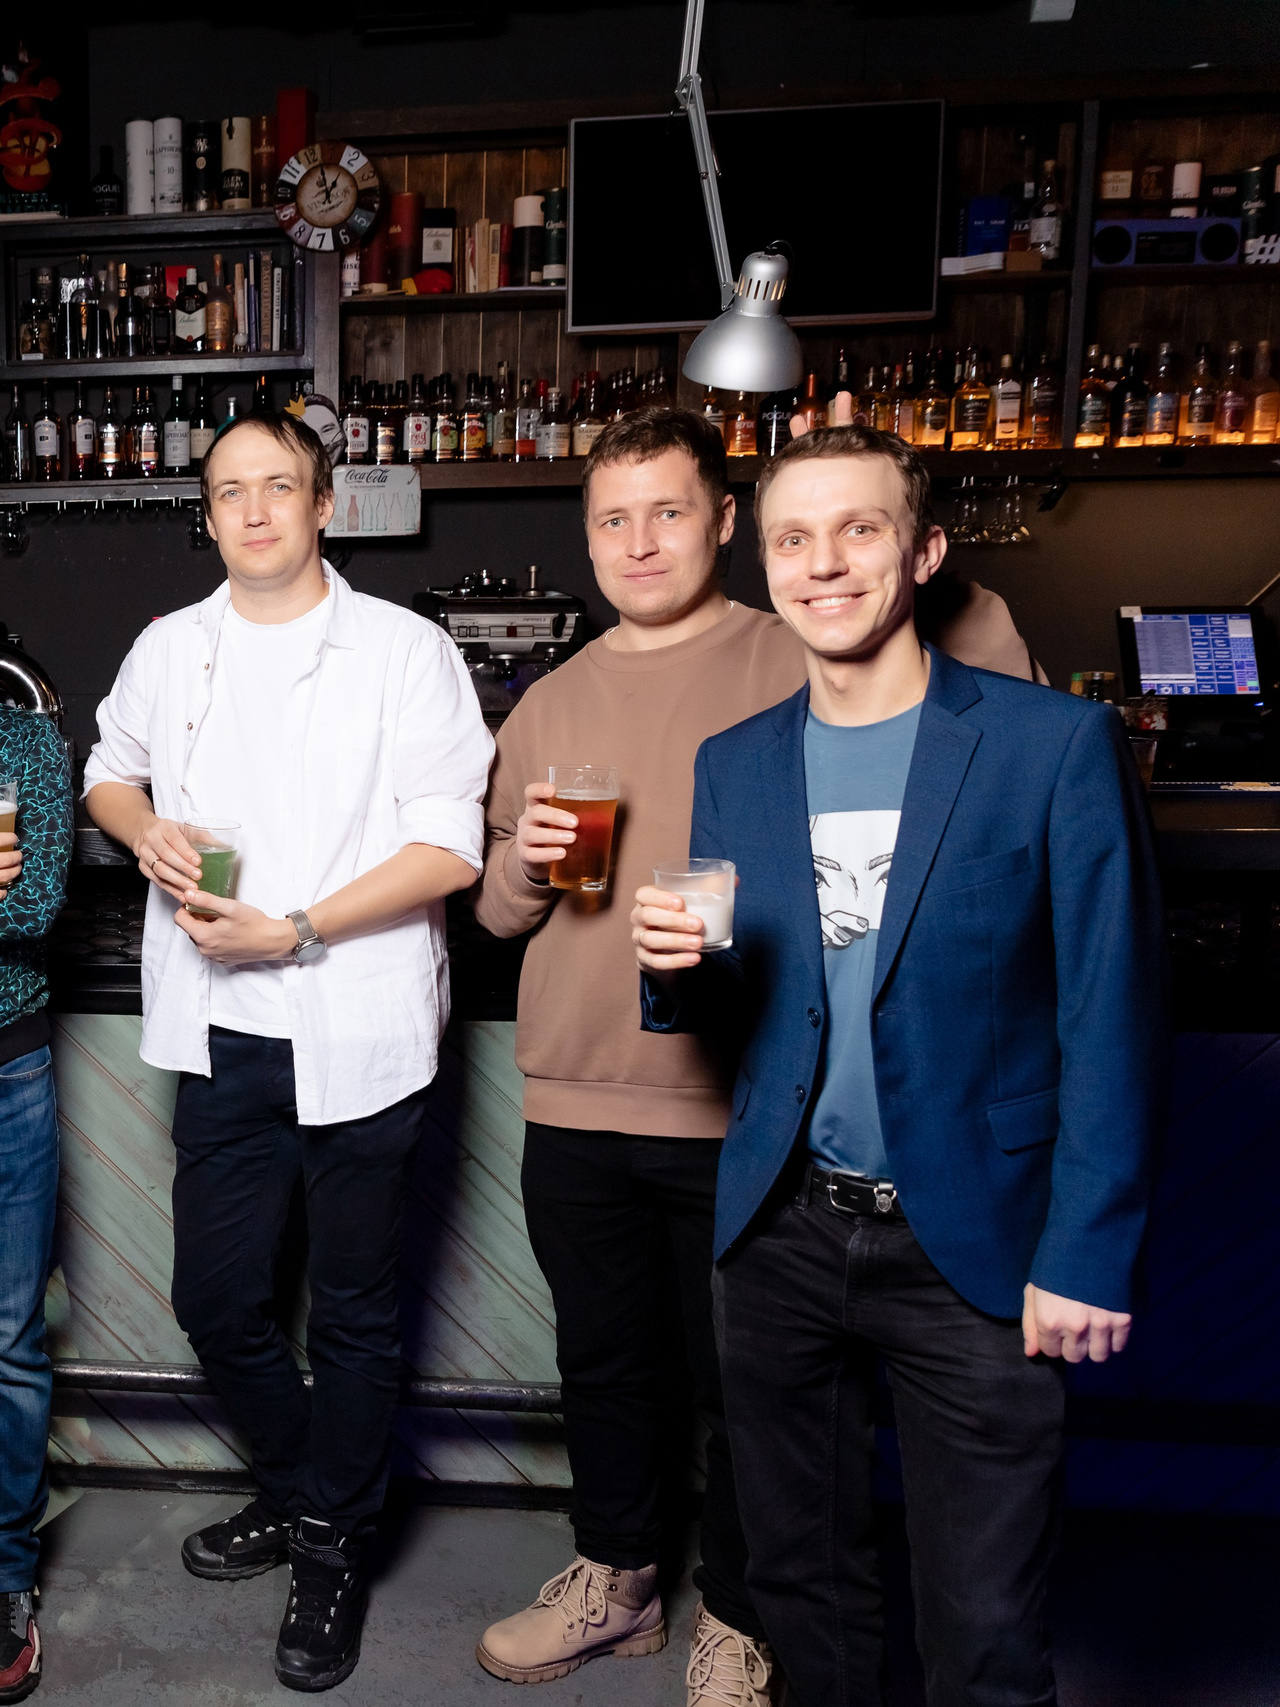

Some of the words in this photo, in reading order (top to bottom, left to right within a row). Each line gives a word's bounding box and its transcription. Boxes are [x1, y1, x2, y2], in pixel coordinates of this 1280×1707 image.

[304, 148, 318, 164] 12
[347, 151, 360, 167] 2
[361, 170, 376, 181] 3
[294, 223, 306, 238] 8
[339, 229, 350, 245] 6
[316, 232, 326, 249] 7
